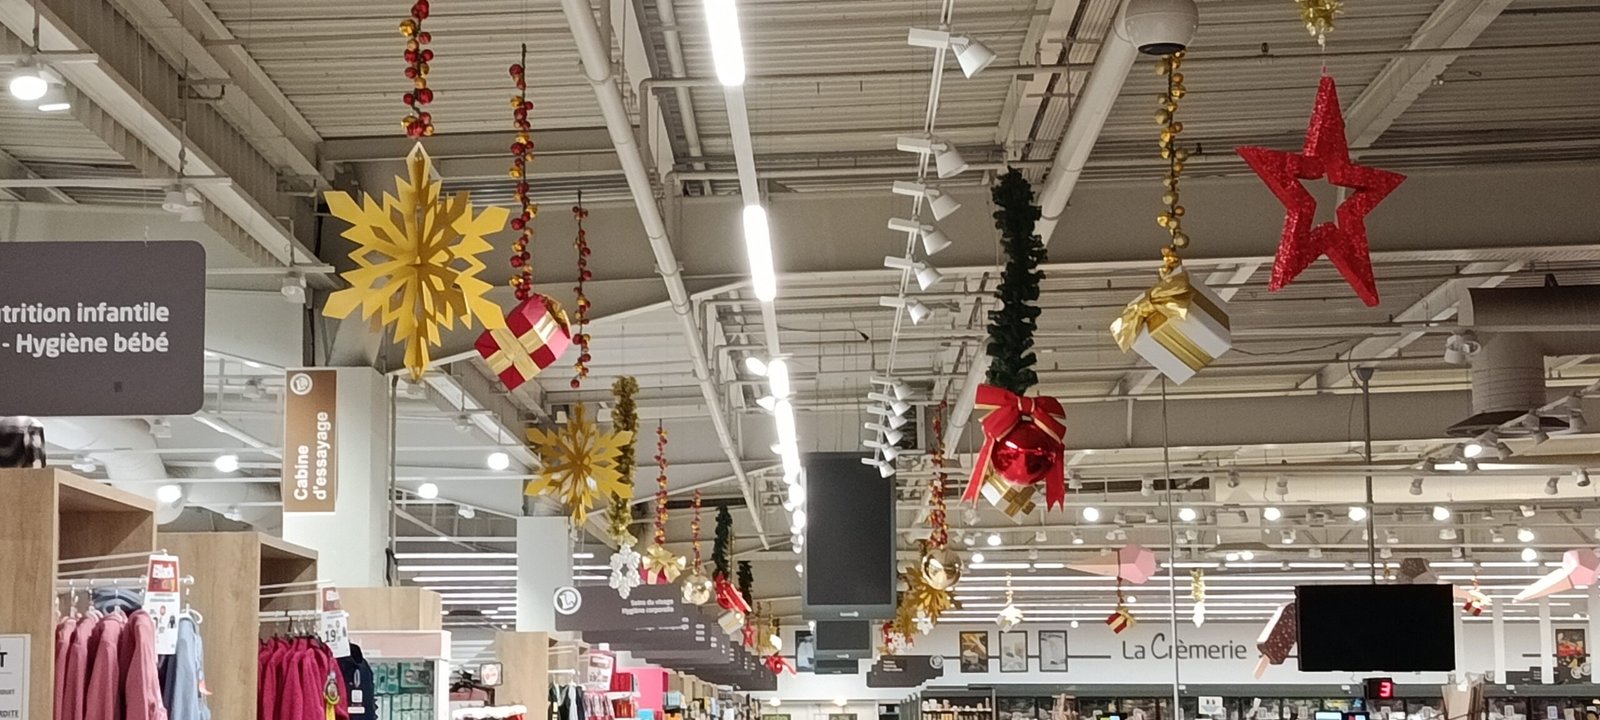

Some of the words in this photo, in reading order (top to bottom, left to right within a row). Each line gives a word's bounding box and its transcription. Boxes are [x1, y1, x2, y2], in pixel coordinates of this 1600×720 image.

[0, 302, 71, 323] trition
[77, 302, 170, 323] infantile
[16, 332, 108, 358] Hygiène
[114, 331, 169, 352] bébé
[312, 411, 331, 500] d'essayage
[293, 445, 309, 500] Cabine
[325, 629, 336, 643] 19
[1122, 640, 1145, 659] La
[1151, 632, 1247, 660] Crèmerie
[1380, 681, 1391, 697] 3
